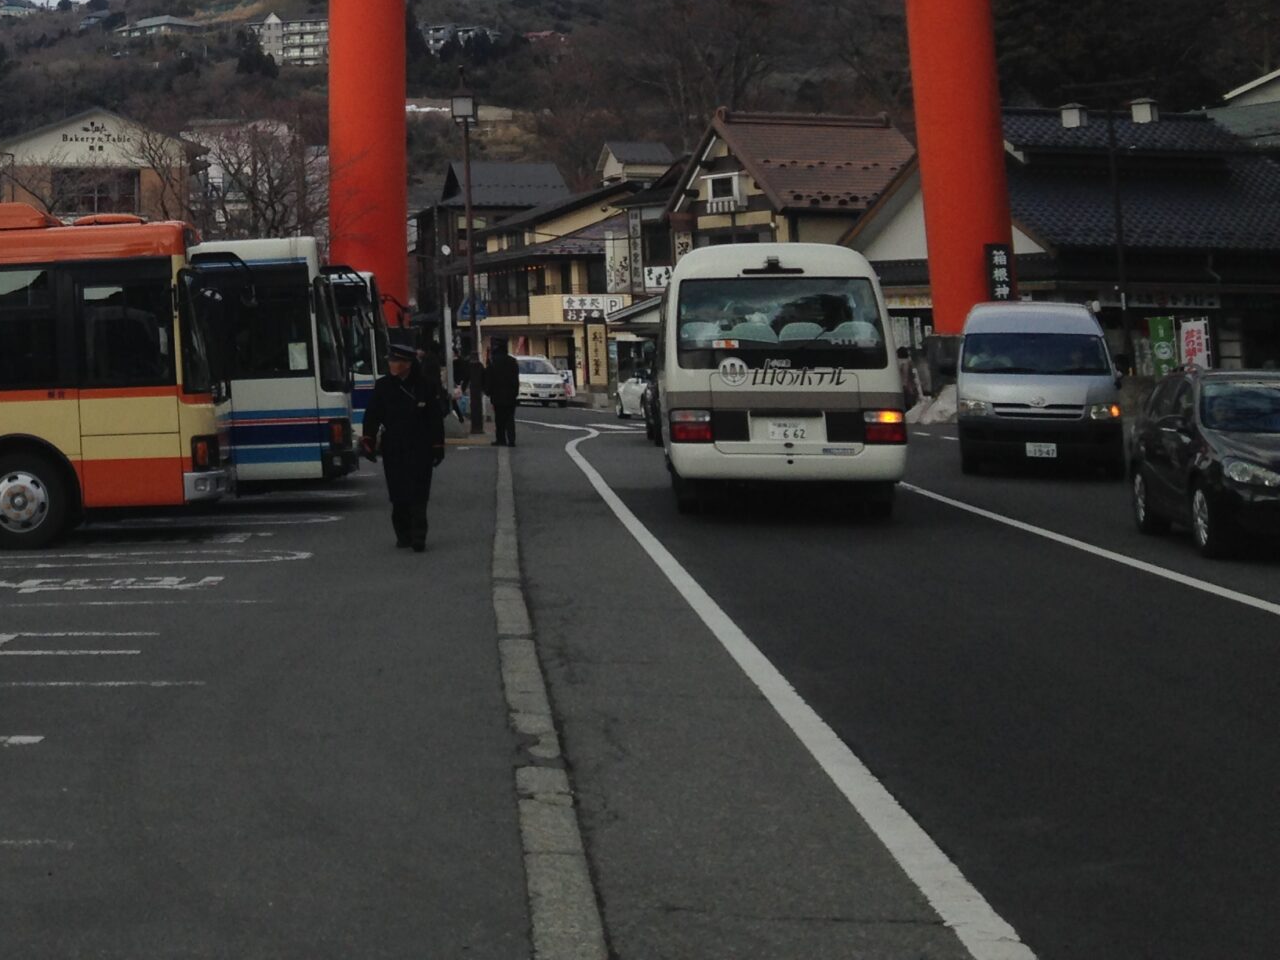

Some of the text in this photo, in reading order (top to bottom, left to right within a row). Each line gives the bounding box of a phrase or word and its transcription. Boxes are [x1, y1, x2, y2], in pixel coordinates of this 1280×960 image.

[62, 134, 95, 144] Bakery
[104, 133, 132, 143] Table
[566, 297, 618, 312] 食事処 P
[751, 359, 847, 387] 山のホテル
